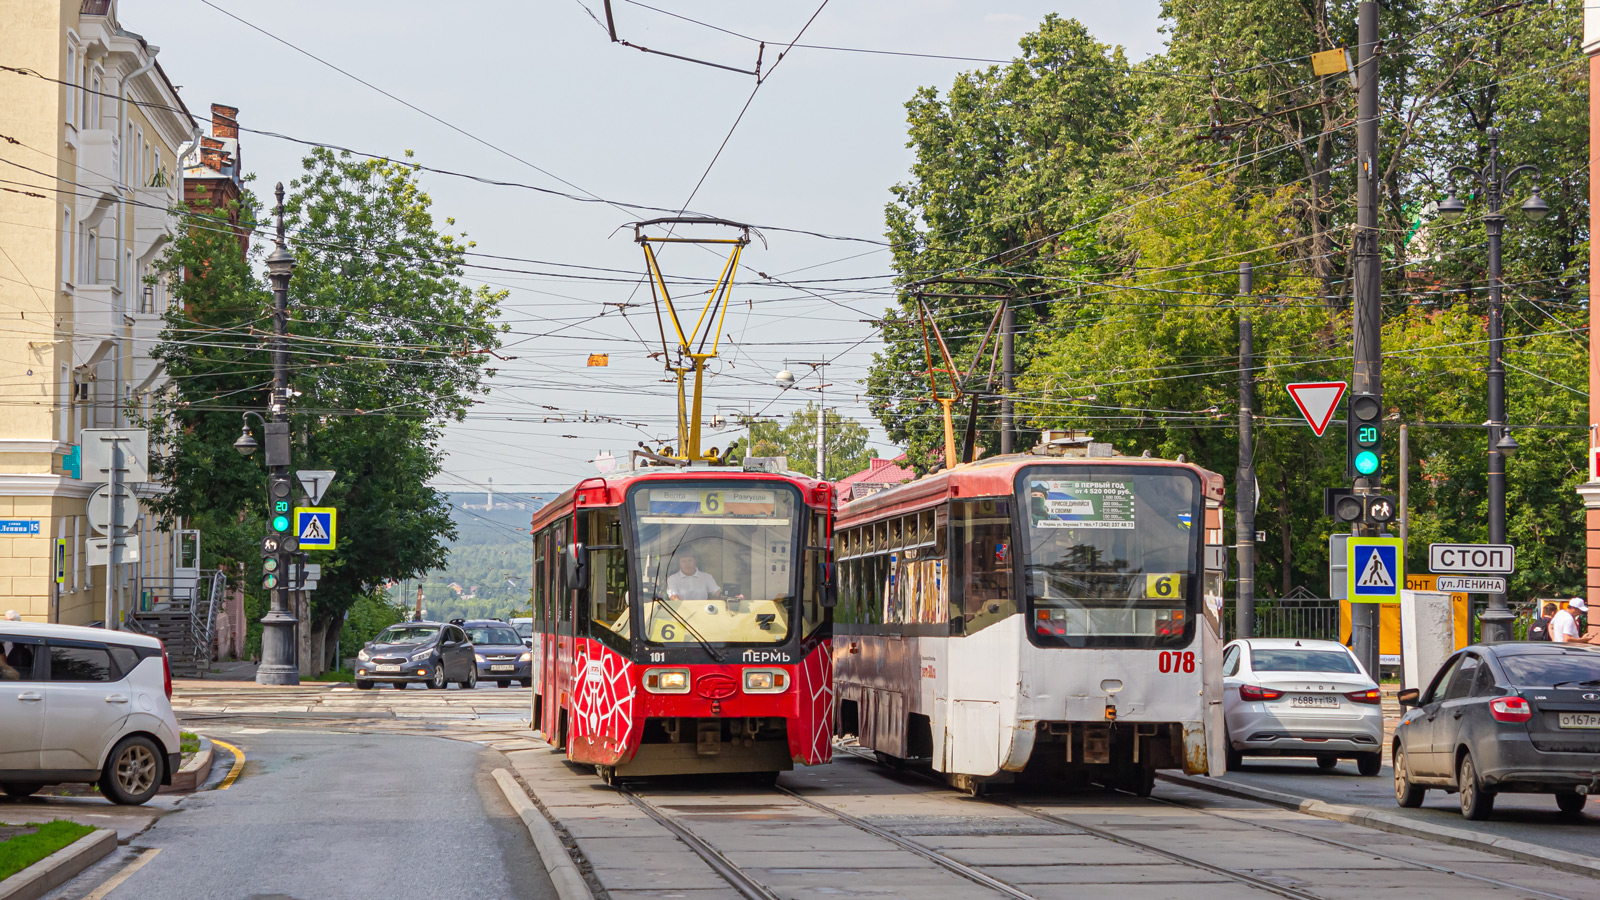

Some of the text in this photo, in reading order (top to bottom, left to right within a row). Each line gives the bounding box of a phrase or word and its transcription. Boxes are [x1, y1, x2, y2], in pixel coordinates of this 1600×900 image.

[1359, 427, 1377, 442] 20
[275, 501, 288, 512] 20
[705, 492, 719, 512] 6
[30, 523, 39, 532] 15
[1440, 549, 1504, 568] СТОП
[1155, 576, 1172, 597] 6
[660, 623, 676, 641] 6
[649, 652, 665, 662] 101
[742, 651, 791, 662] ПЕРМЬ
[1158, 650, 1196, 674] 078
